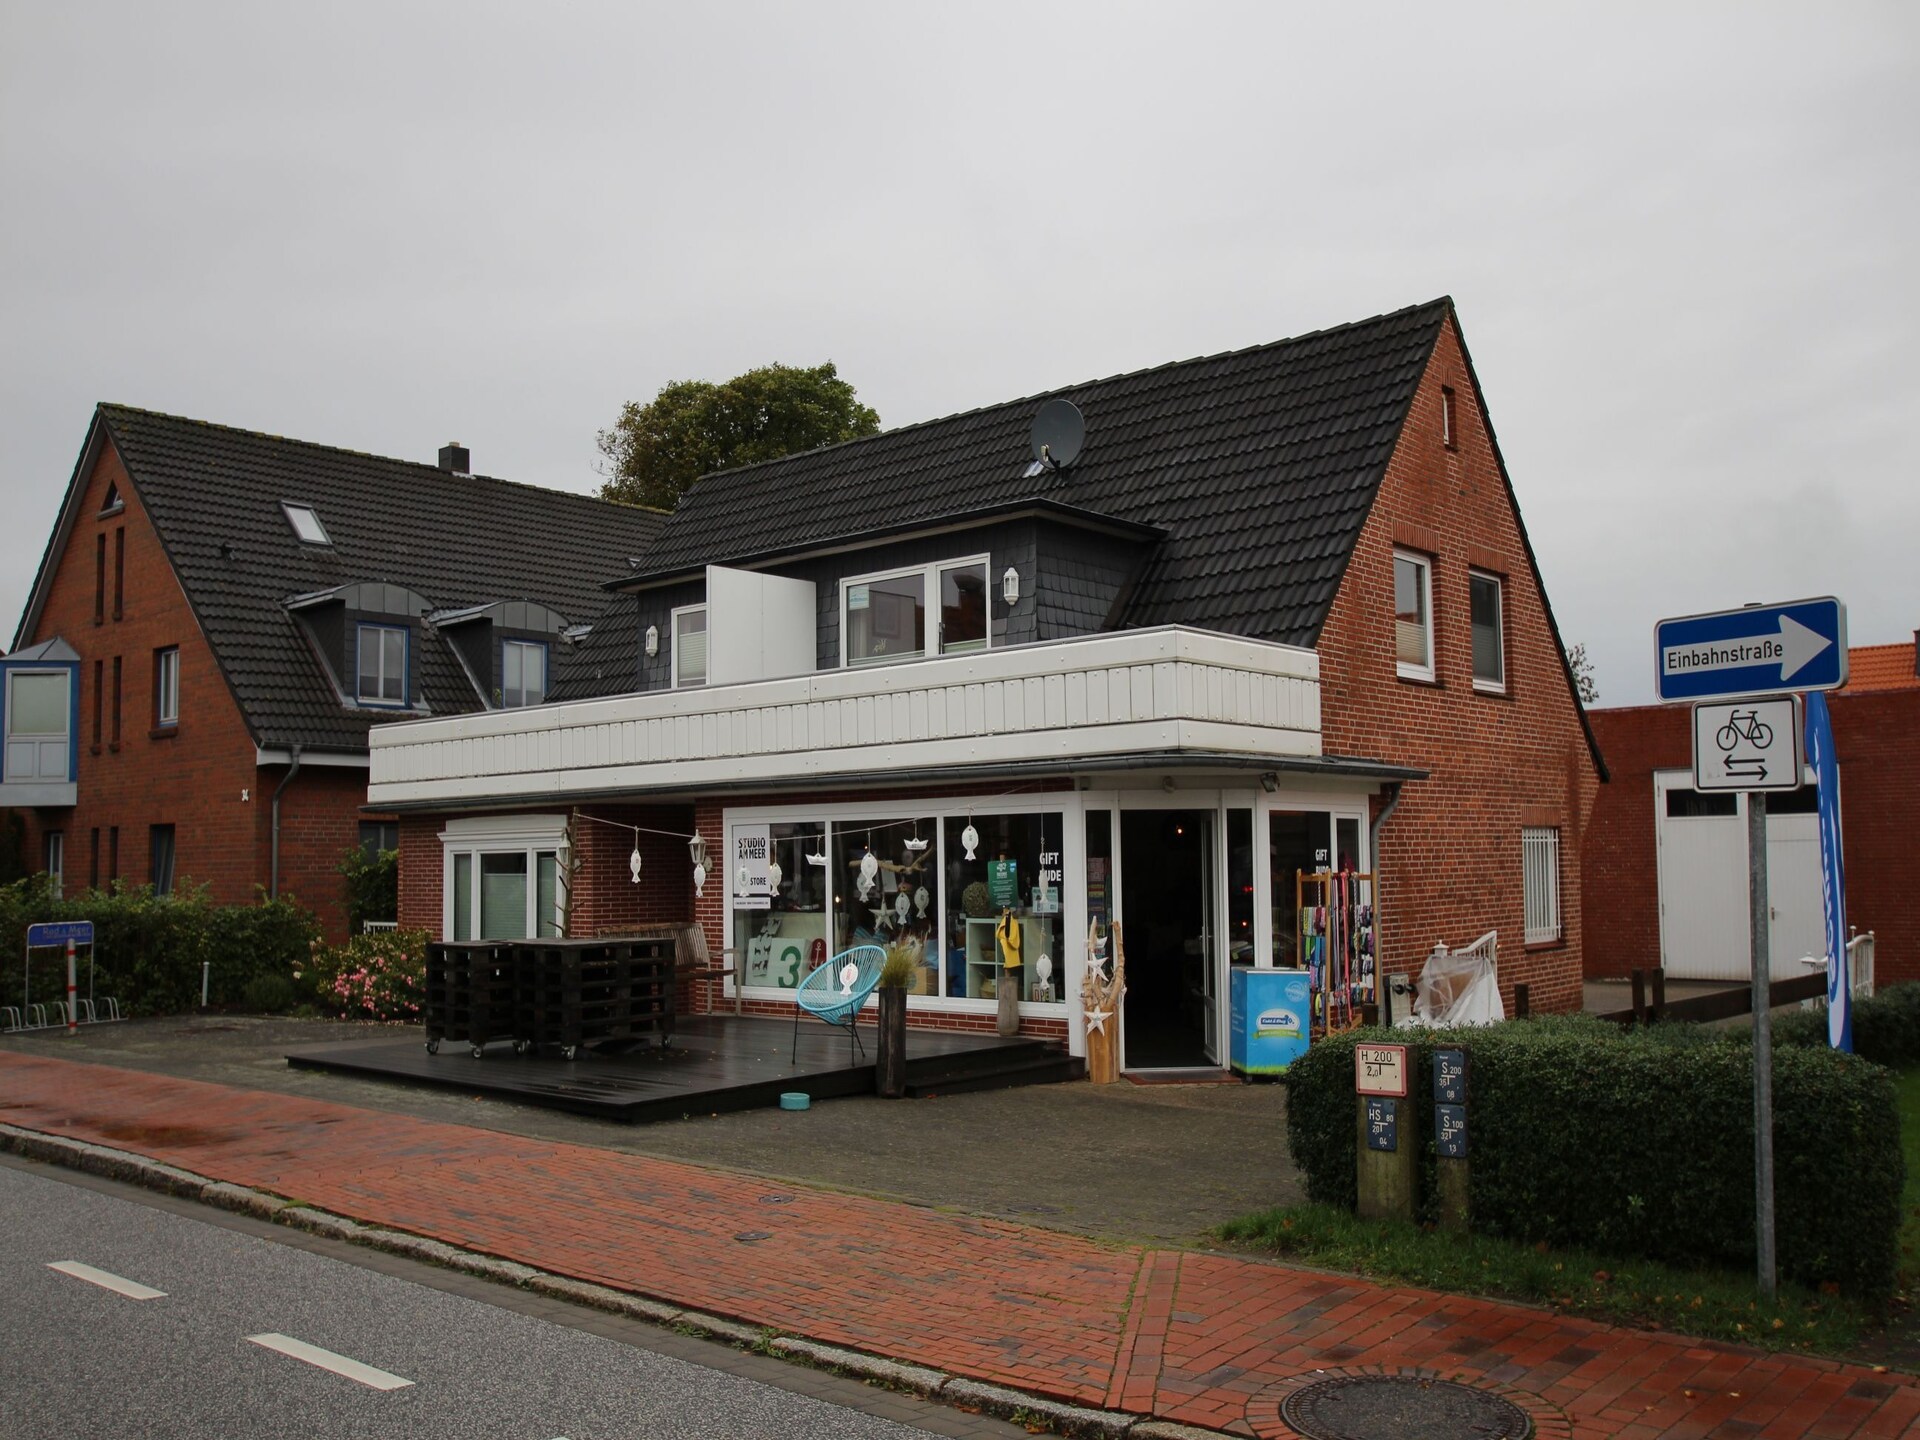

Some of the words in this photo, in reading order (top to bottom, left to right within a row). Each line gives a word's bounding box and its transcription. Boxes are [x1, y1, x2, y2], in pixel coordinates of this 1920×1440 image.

[1668, 640, 1783, 669] Einbahnstraße
[738, 837, 766, 848] STUDIO
[749, 848, 766, 859] MEER
[1039, 852, 1059, 865] GIFT
[750, 877, 767, 886] STORE
[778, 946, 801, 988] 3
[1361, 1050, 1368, 1061] H
[1374, 1051, 1392, 1062] 200
[1441, 1061, 1448, 1074] S
[1450, 1066, 1461, 1075] 200
[1369, 1108, 1381, 1121] HS
[1443, 1115, 1450, 1128] S
[1452, 1120, 1464, 1129] 100
